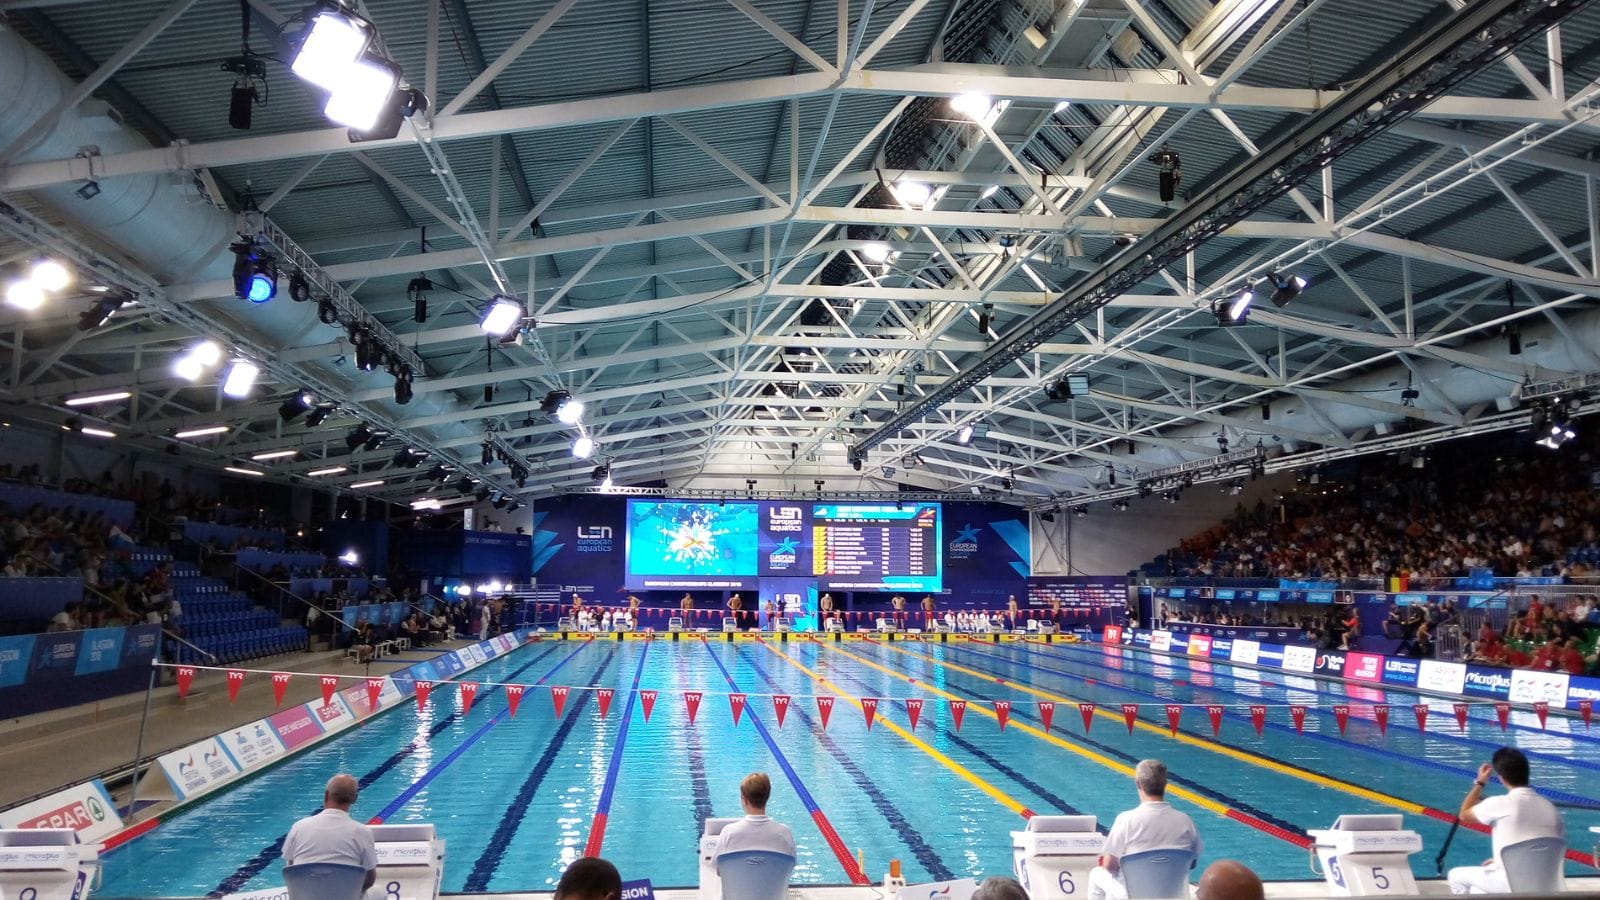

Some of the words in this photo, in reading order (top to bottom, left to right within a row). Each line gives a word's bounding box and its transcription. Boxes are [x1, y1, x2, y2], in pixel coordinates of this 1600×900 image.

[179, 668, 193, 676] TYR
[322, 677, 336, 685] TYR
[508, 686, 522, 694] TYR
[642, 692, 655, 700] TYR
[686, 694, 700, 702] TYR
[730, 695, 744, 703] TYR
[819, 699, 832, 707] TYR
[908, 701, 921, 709] TYR
[995, 701, 1008, 709] TYR
[1081, 704, 1094, 712] TYR
[1123, 705, 1137, 713] TYR
[1167, 706, 1180, 714] TYR
[1209, 706, 1222, 714] TYR
[1252, 707, 1264, 715] TYR
[1292, 707, 1305, 715] TYR
[1335, 707, 1348, 715] TYR
[1058, 870, 1075, 895] 6
[1372, 867, 1390, 890] 5
